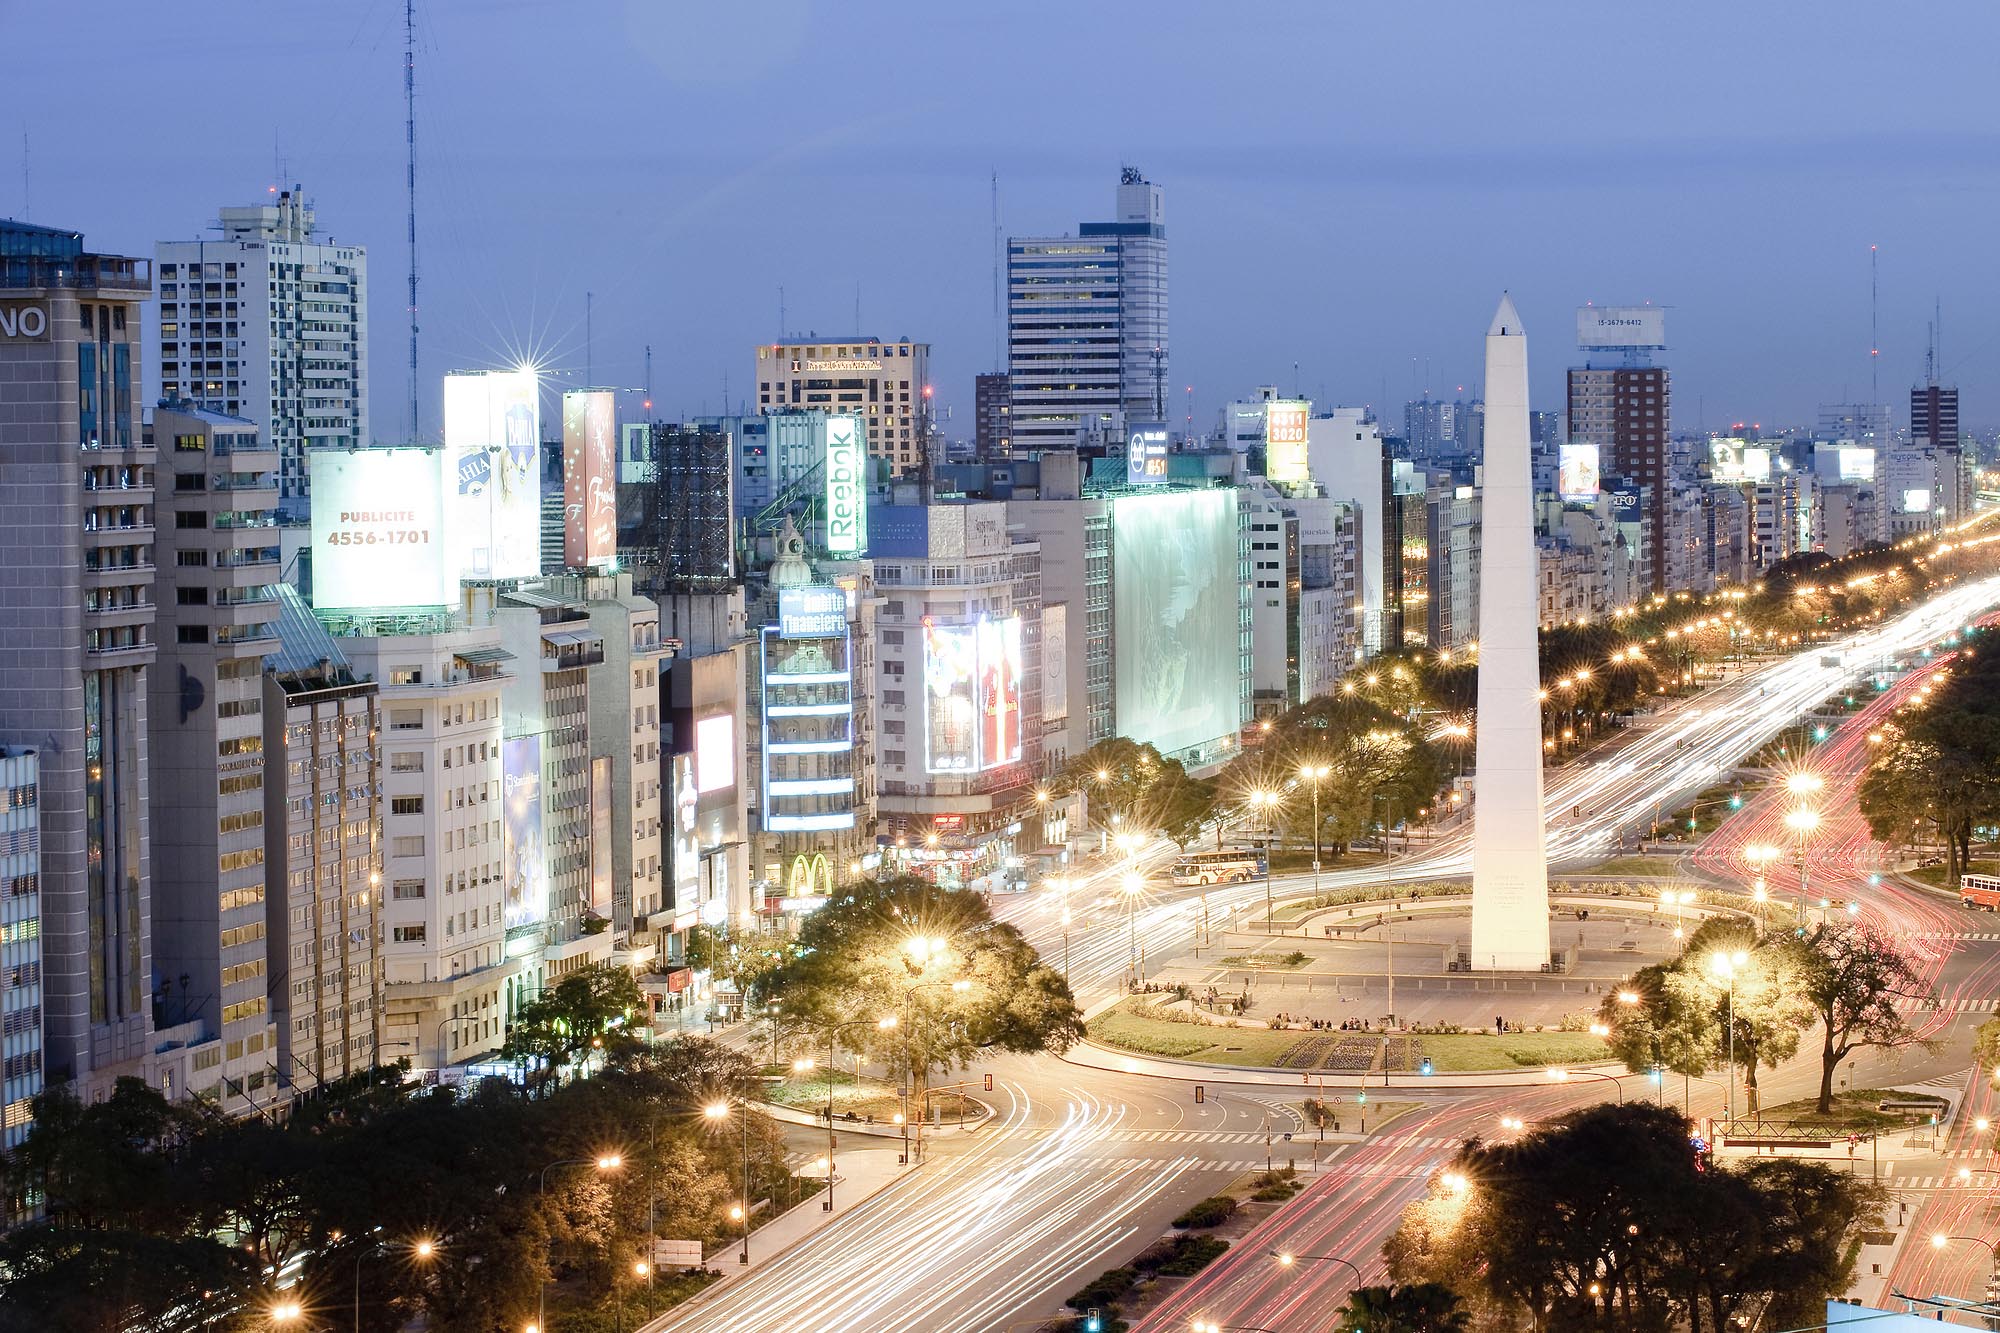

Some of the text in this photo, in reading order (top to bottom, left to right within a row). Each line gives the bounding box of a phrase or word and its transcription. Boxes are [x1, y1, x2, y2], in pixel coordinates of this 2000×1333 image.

[1272, 427, 1303, 441] 3020
[458, 456, 491, 487] AHIA
[829, 432, 852, 537] Reebok
[340, 511, 415, 523] PUBLICITE
[327, 529, 429, 546] 4556-1701
